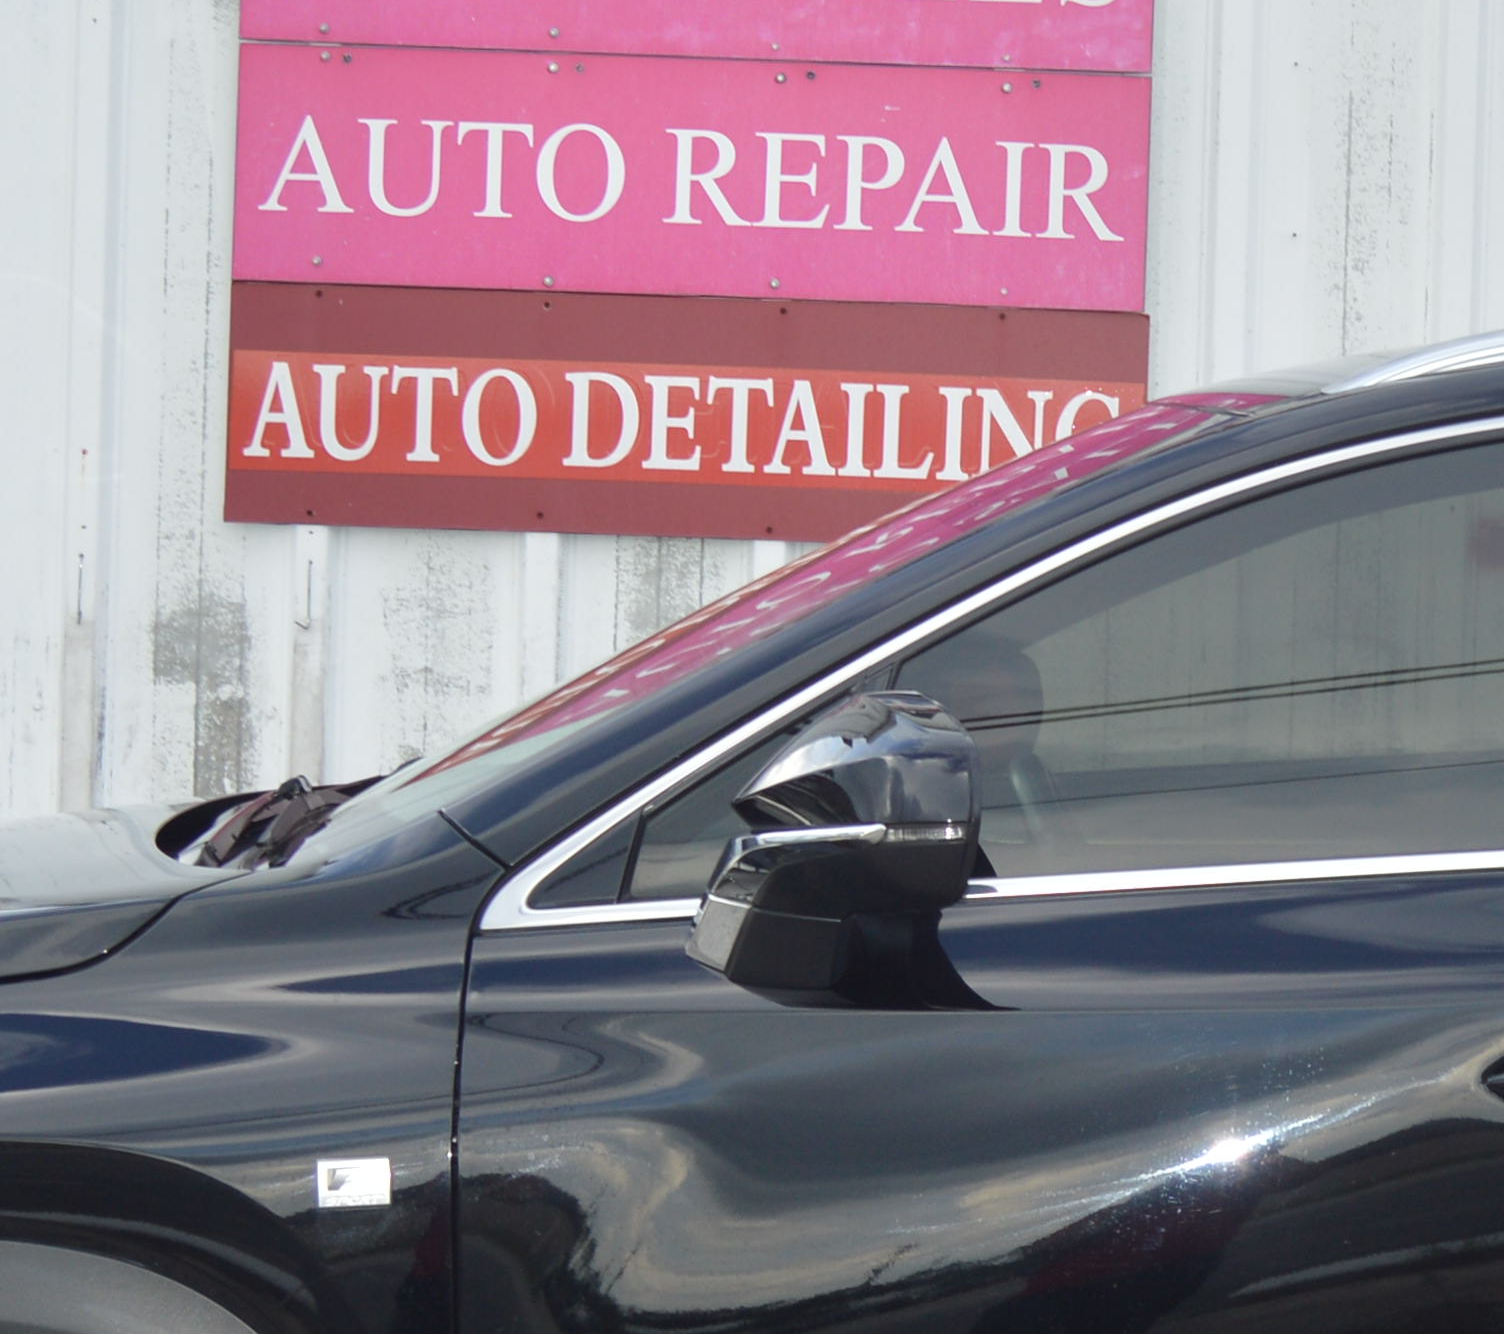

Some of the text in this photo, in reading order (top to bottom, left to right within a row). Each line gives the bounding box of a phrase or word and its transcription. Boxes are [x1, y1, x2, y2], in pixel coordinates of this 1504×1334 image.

[257, 113, 1124, 242] AUTO REPAIR
[242, 360, 539, 467] AUTO
